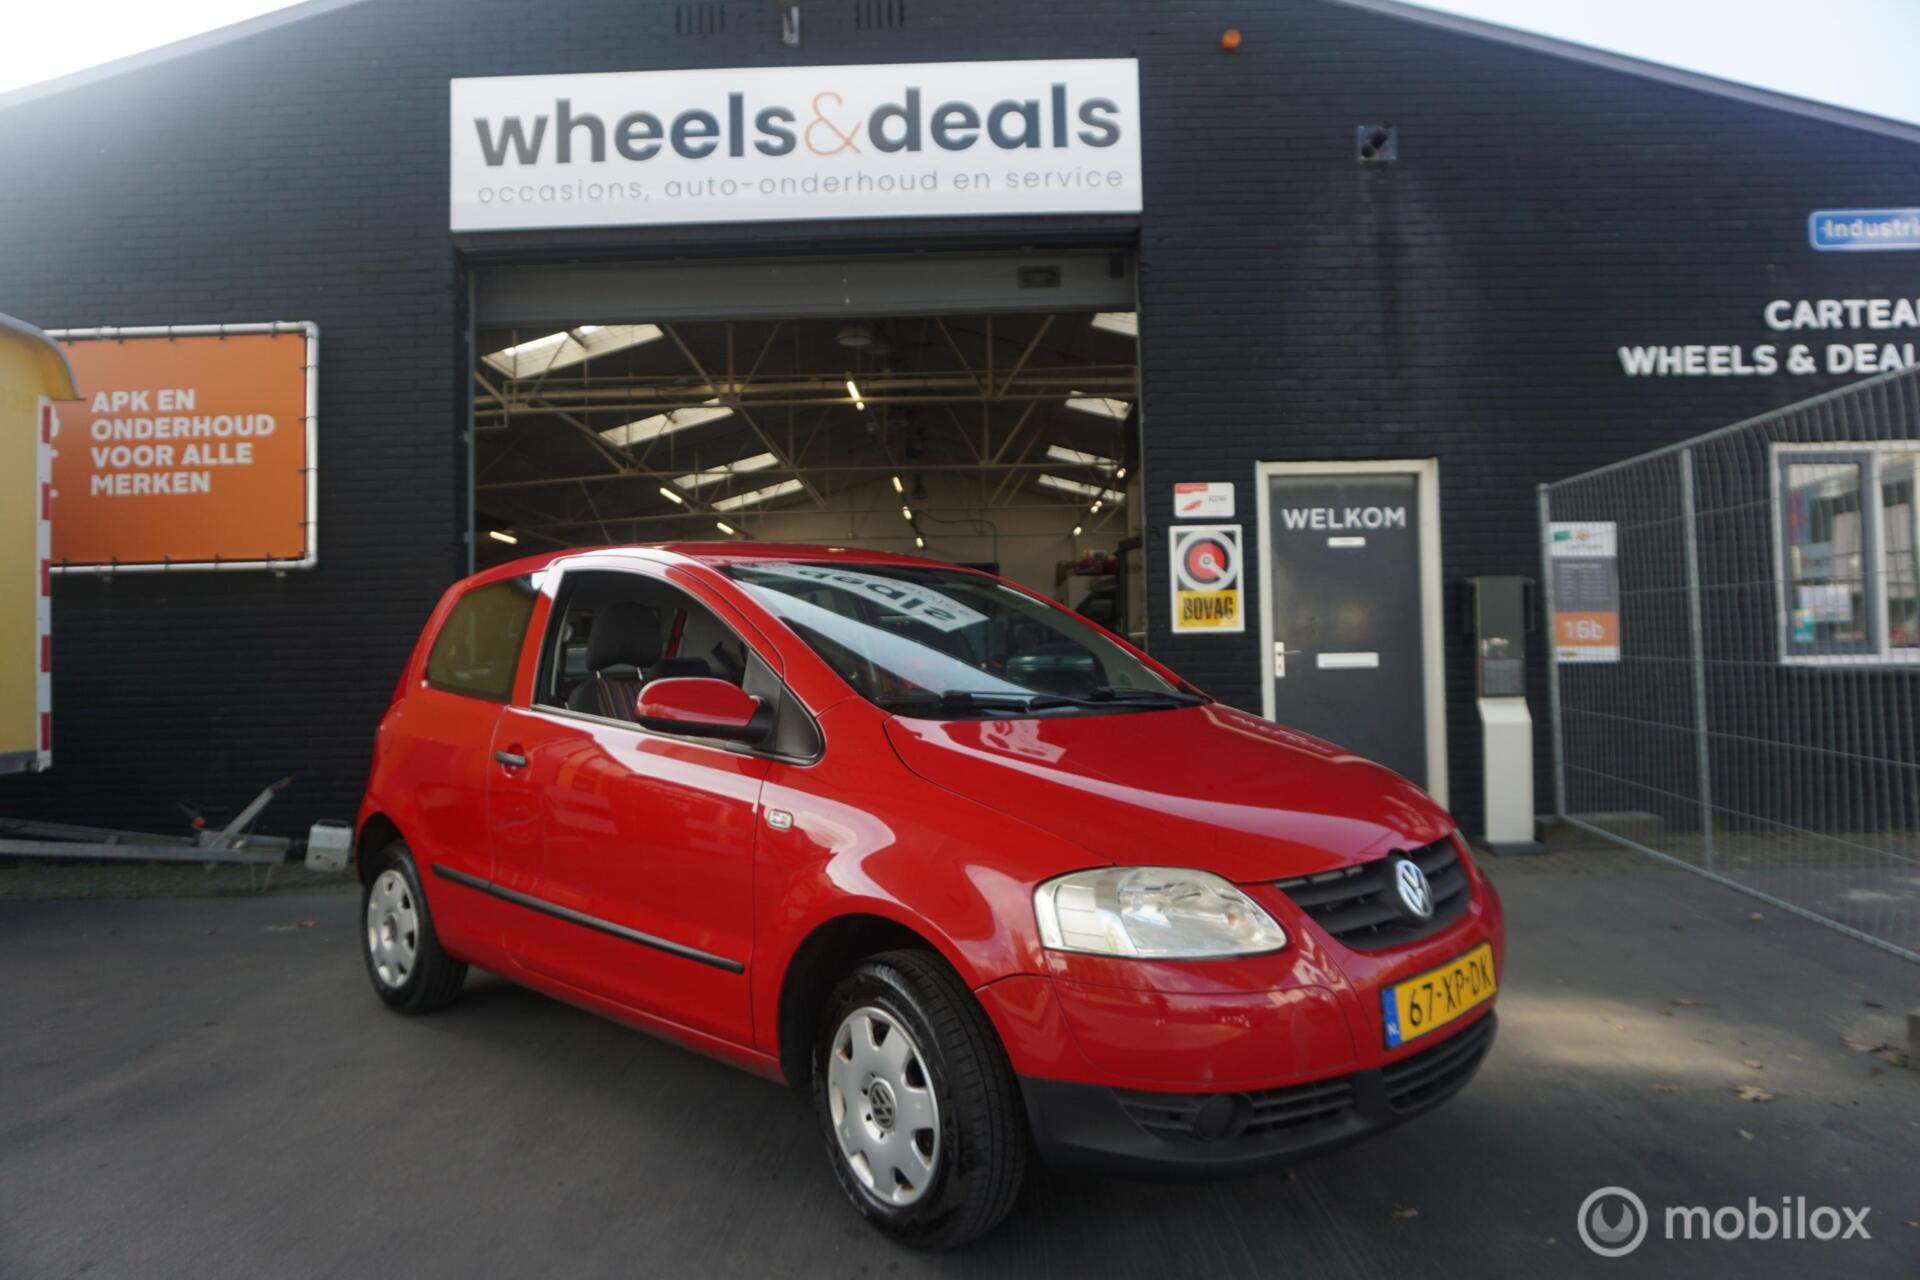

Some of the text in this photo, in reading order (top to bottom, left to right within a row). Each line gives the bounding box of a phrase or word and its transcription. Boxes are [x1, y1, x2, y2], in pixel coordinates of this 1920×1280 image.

[474, 83, 1122, 167] wheels&deals
[478, 165, 1124, 204] occasions, auto-onderhoud en service
[1764, 299, 1920, 330] CARTEA
[1618, 345, 1779, 376] WHEELS
[1786, 344, 1817, 375] &
[91, 388, 196, 413] APK EN
[90, 414, 275, 440] ONDERHOUD
[91, 442, 254, 468] VOOR ALLE
[91, 471, 211, 496] MERKEN
[1282, 506, 1406, 530] WELKOM
[1183, 596, 1234, 620] BOVAG
